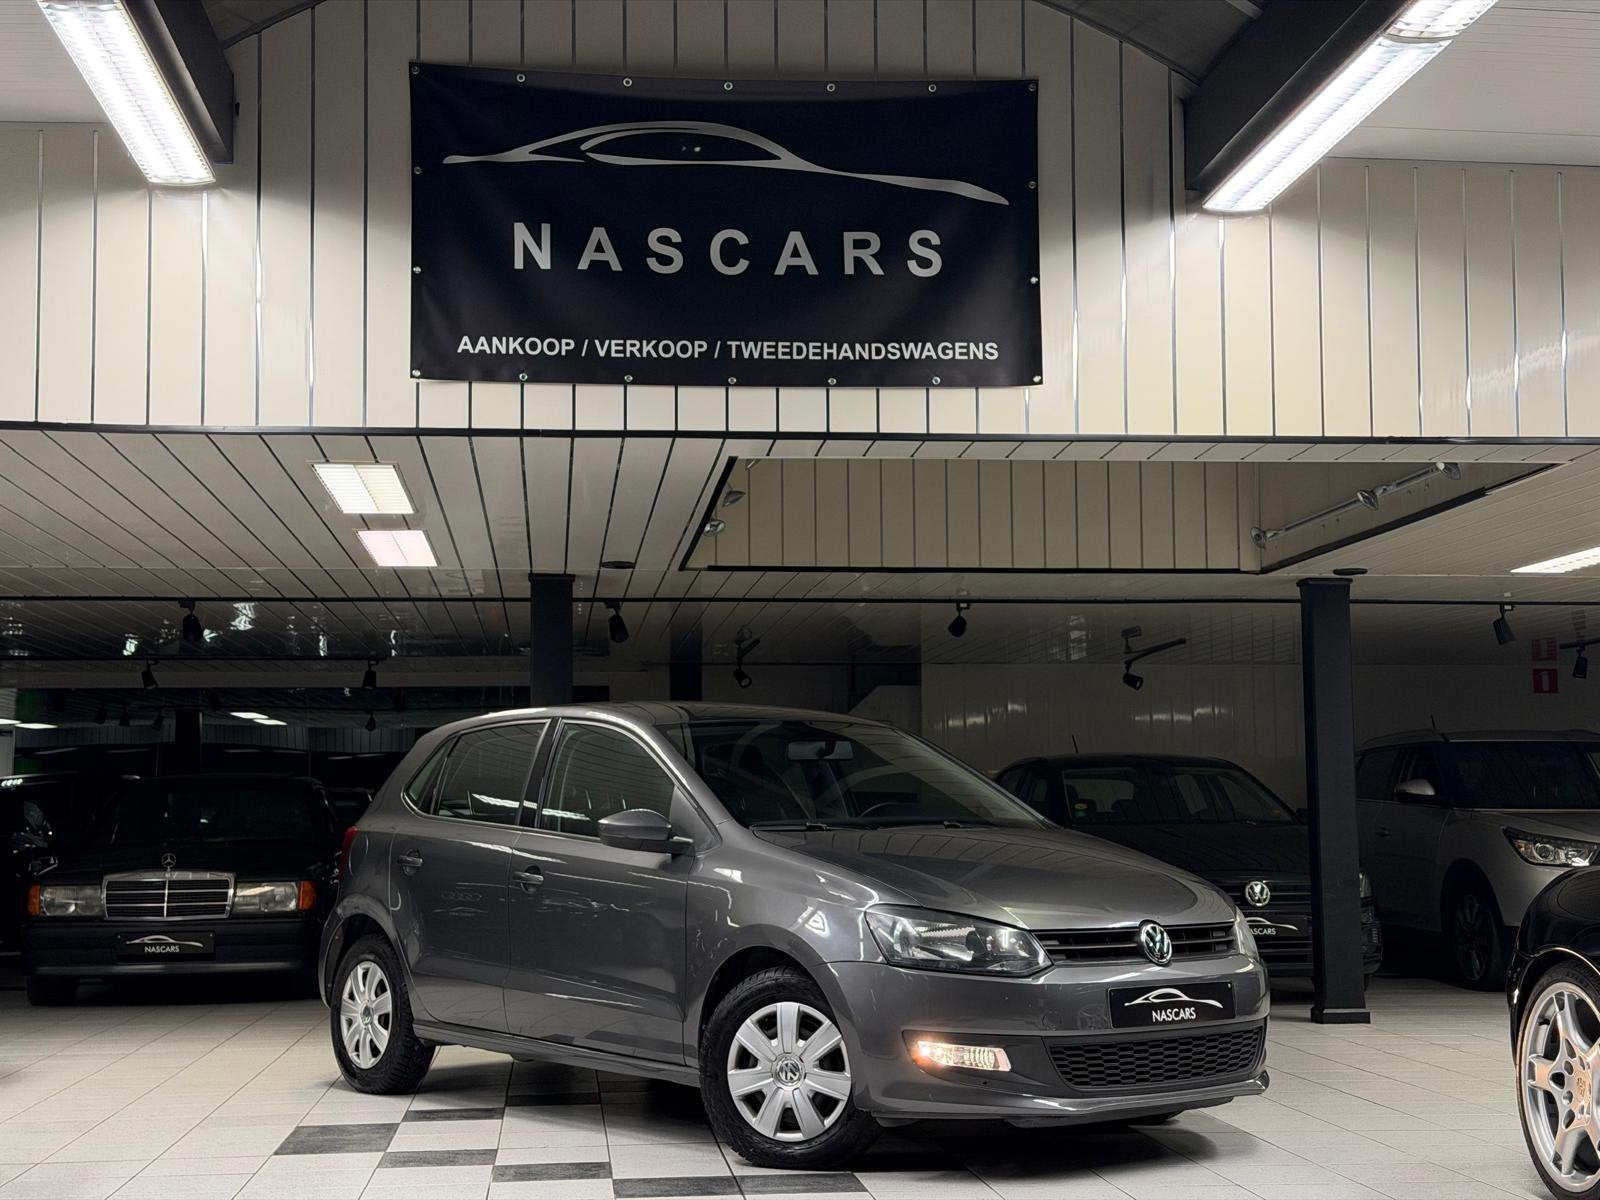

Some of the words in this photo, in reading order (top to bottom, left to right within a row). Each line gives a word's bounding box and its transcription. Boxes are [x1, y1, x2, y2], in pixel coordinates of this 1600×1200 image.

[513, 222, 943, 278] NASCARS
[456, 335, 575, 358] AANKOOP
[594, 338, 709, 359] VERKOOP
[726, 341, 999, 361] TWEEDEHANDSWAGENS
[144, 945, 180, 953] NASCARS
[1151, 1006, 1197, 1023] NASCARS
